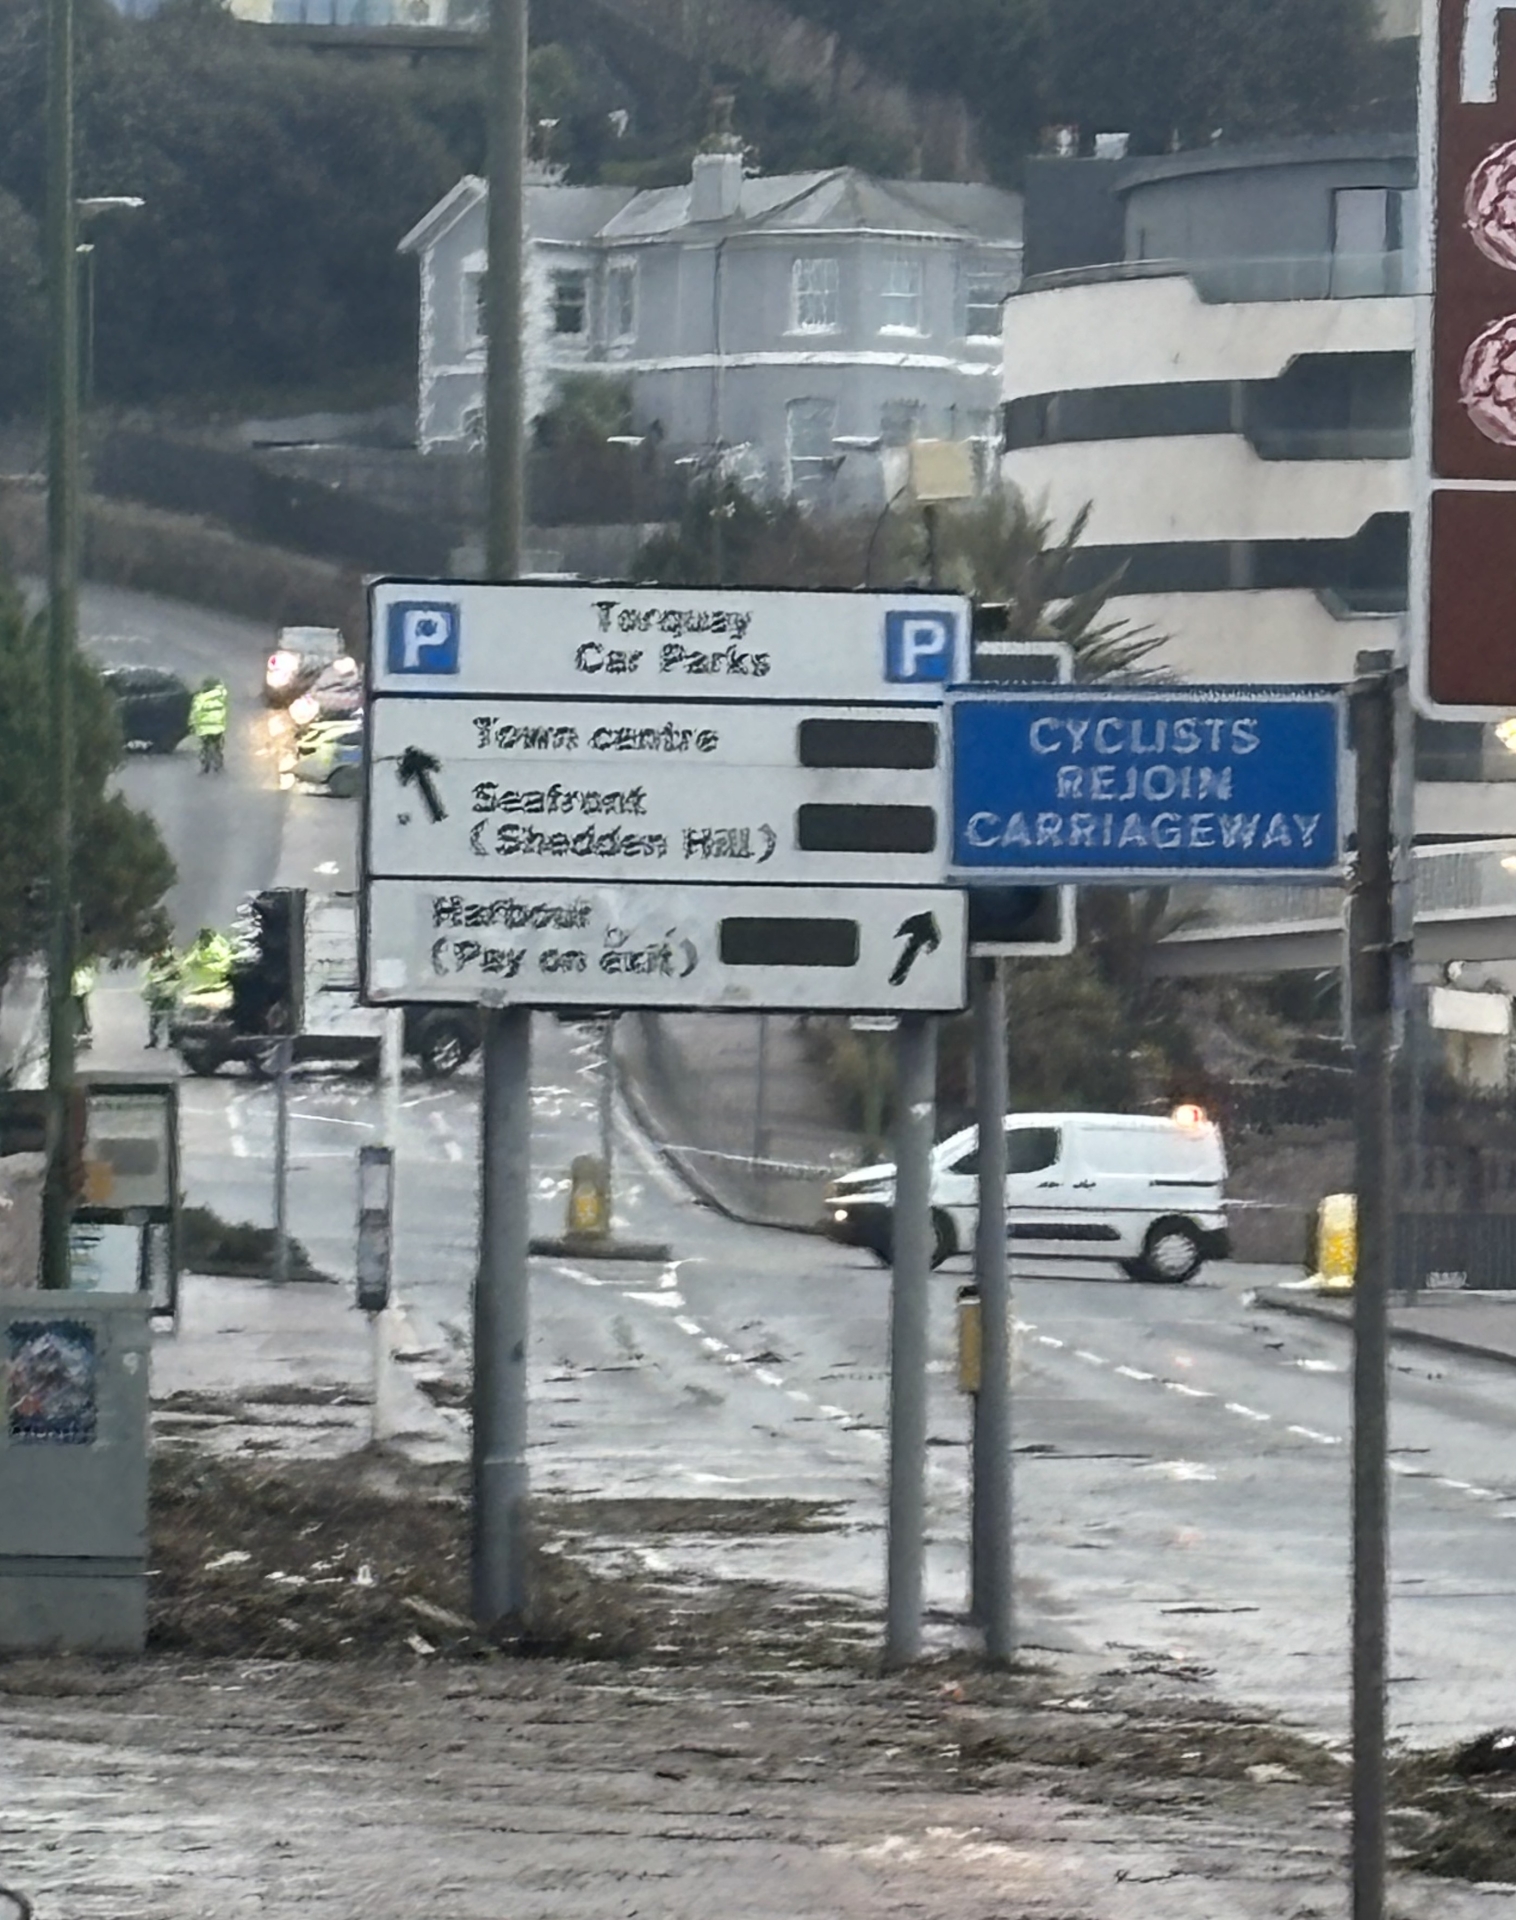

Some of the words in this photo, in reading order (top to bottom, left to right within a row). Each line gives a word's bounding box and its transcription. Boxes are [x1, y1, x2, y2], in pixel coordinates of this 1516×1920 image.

[591, 600, 752, 640] Torquay
[575, 641, 643, 674] Car
[659, 643, 771, 677] Parks
[473, 716, 579, 750] Town
[586, 721, 719, 752] centre
[1029, 717, 1260, 754] CYCLISTS
[472, 781, 647, 816] Seafront
[1056, 764, 1233, 801] REJOIN
[470, 818, 668, 859] (Shedden
[682, 823, 777, 863] Hill)
[965, 811, 1321, 849] CARRIAGEWAY
[432, 895, 592, 930] Harbour
[432, 936, 527, 978] (Pay
[538, 949, 588, 973] on
